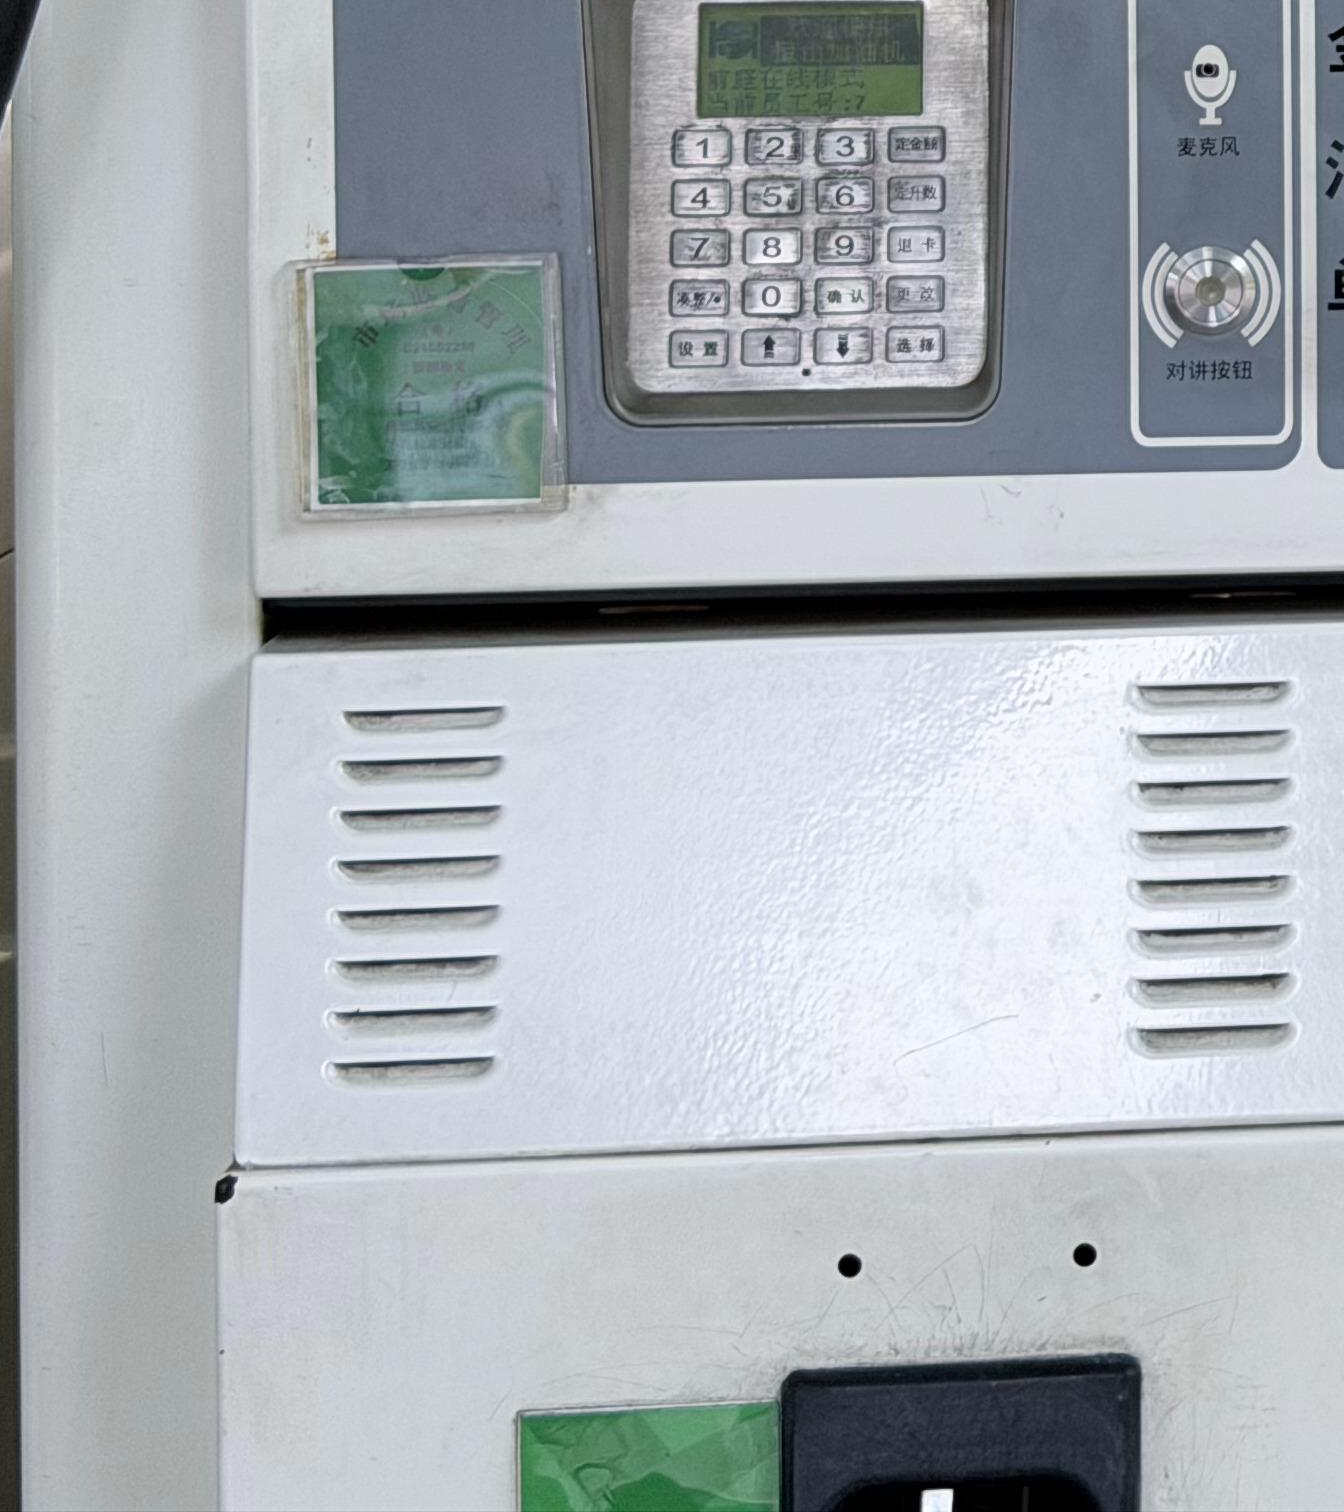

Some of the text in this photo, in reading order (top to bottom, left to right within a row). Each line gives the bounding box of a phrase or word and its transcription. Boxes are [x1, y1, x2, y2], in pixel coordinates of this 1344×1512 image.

[695, 138, 709, 159] 1
[765, 137, 785, 158] 2
[836, 136, 855, 157] 3
[1177, 137, 1240, 157] 麦克风
[690, 188, 711, 209] 4
[763, 187, 782, 207] 5
[835, 186, 855, 206] 6
[690, 238, 710, 260] 7
[763, 236, 782, 258] 8
[835, 235, 855, 256] 9
[762, 286, 781, 307] 0
[1166, 361, 1253, 381] 对讲按钮
